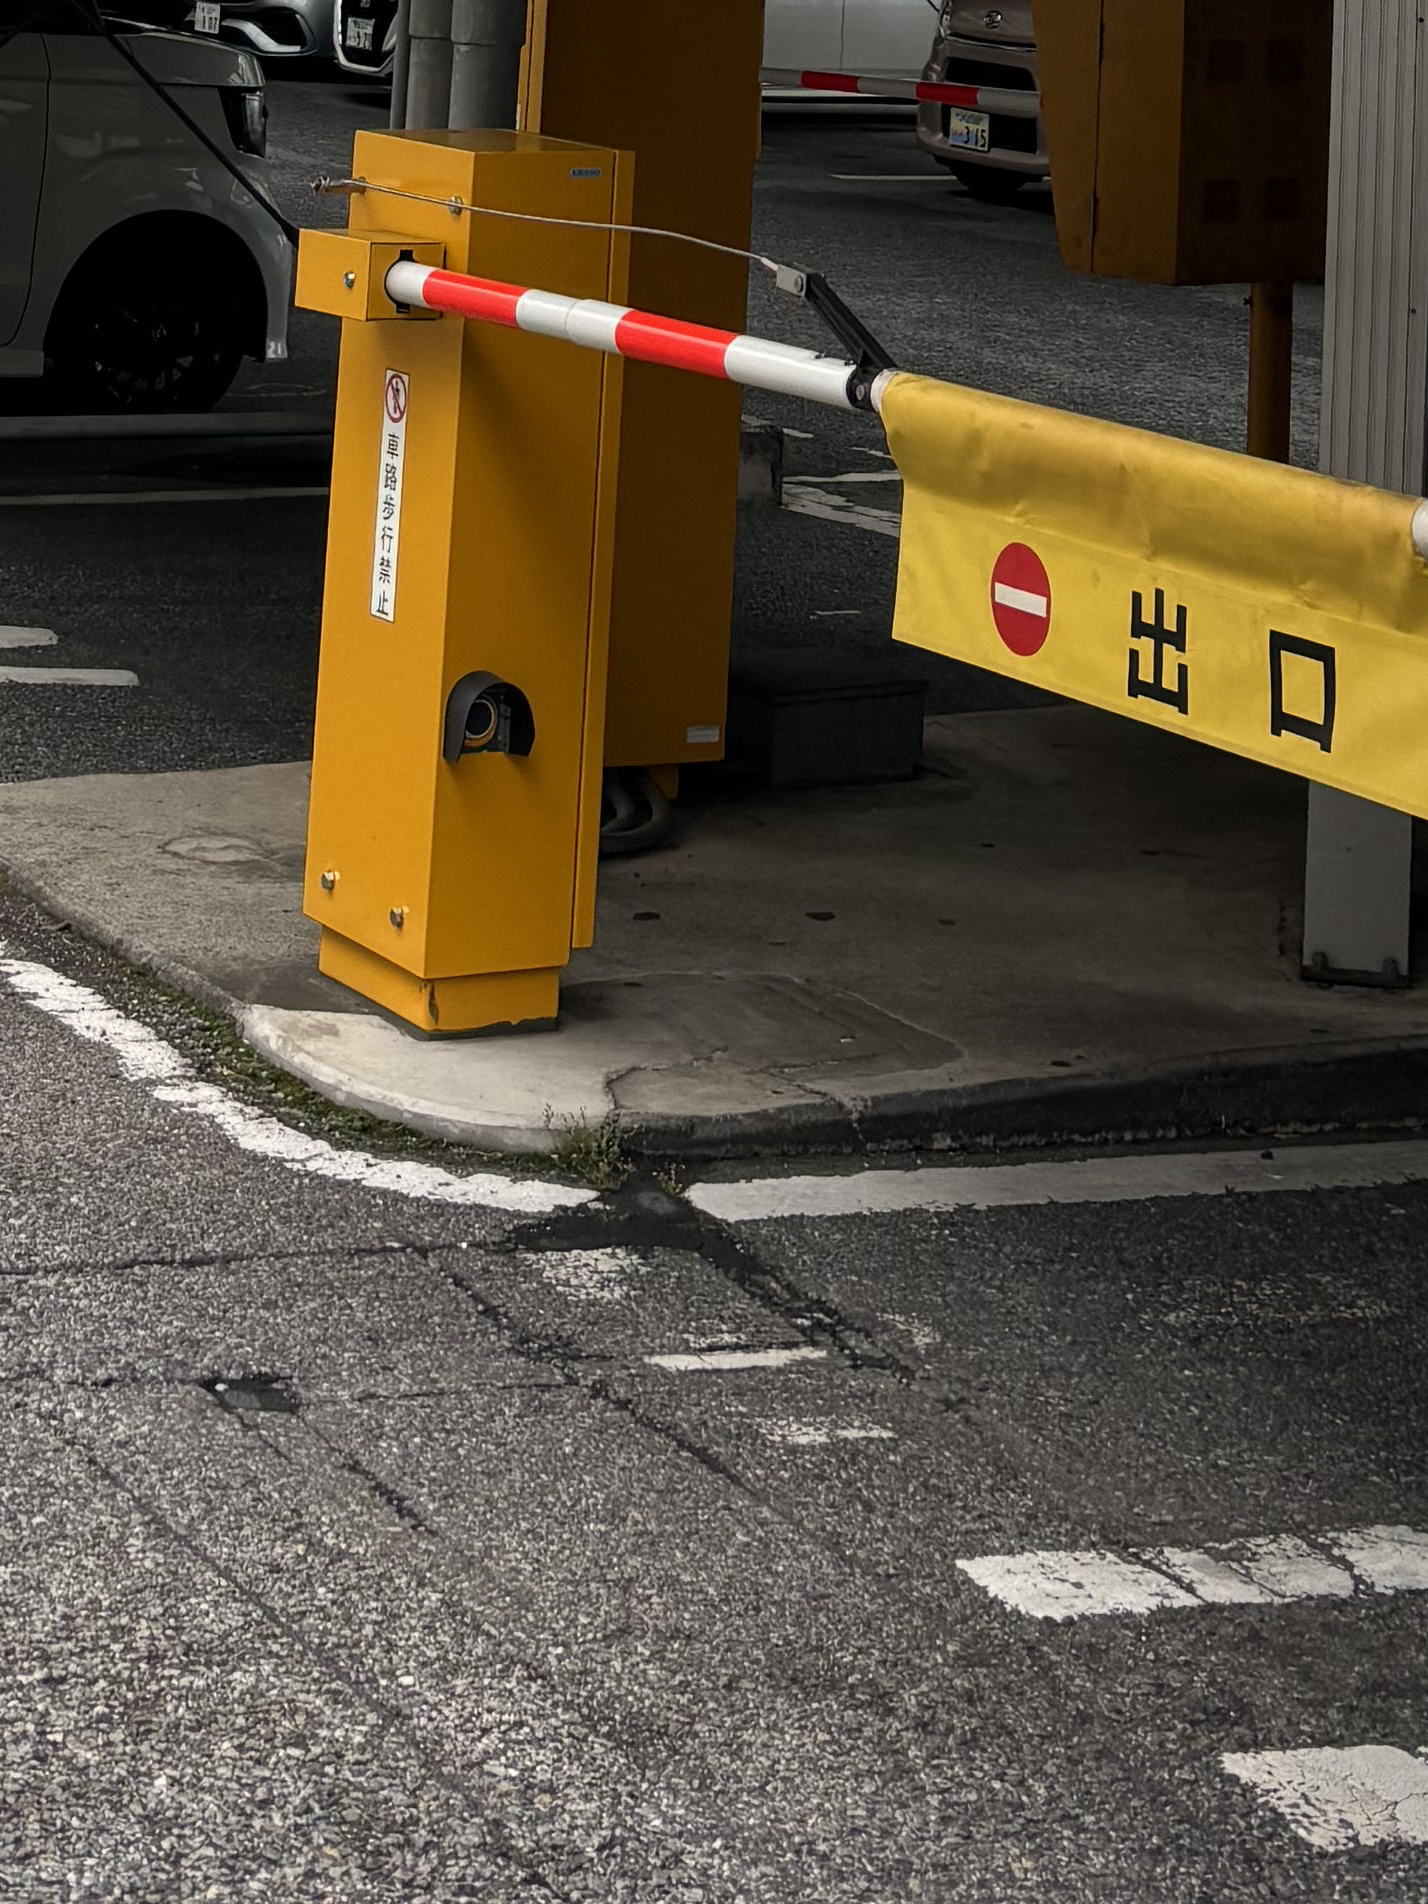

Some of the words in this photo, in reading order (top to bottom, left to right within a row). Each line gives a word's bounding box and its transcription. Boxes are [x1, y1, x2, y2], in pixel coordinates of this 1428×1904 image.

[376, 432, 399, 617] 車路歩行禁止
[1127, 587, 1337, 754] 出口
